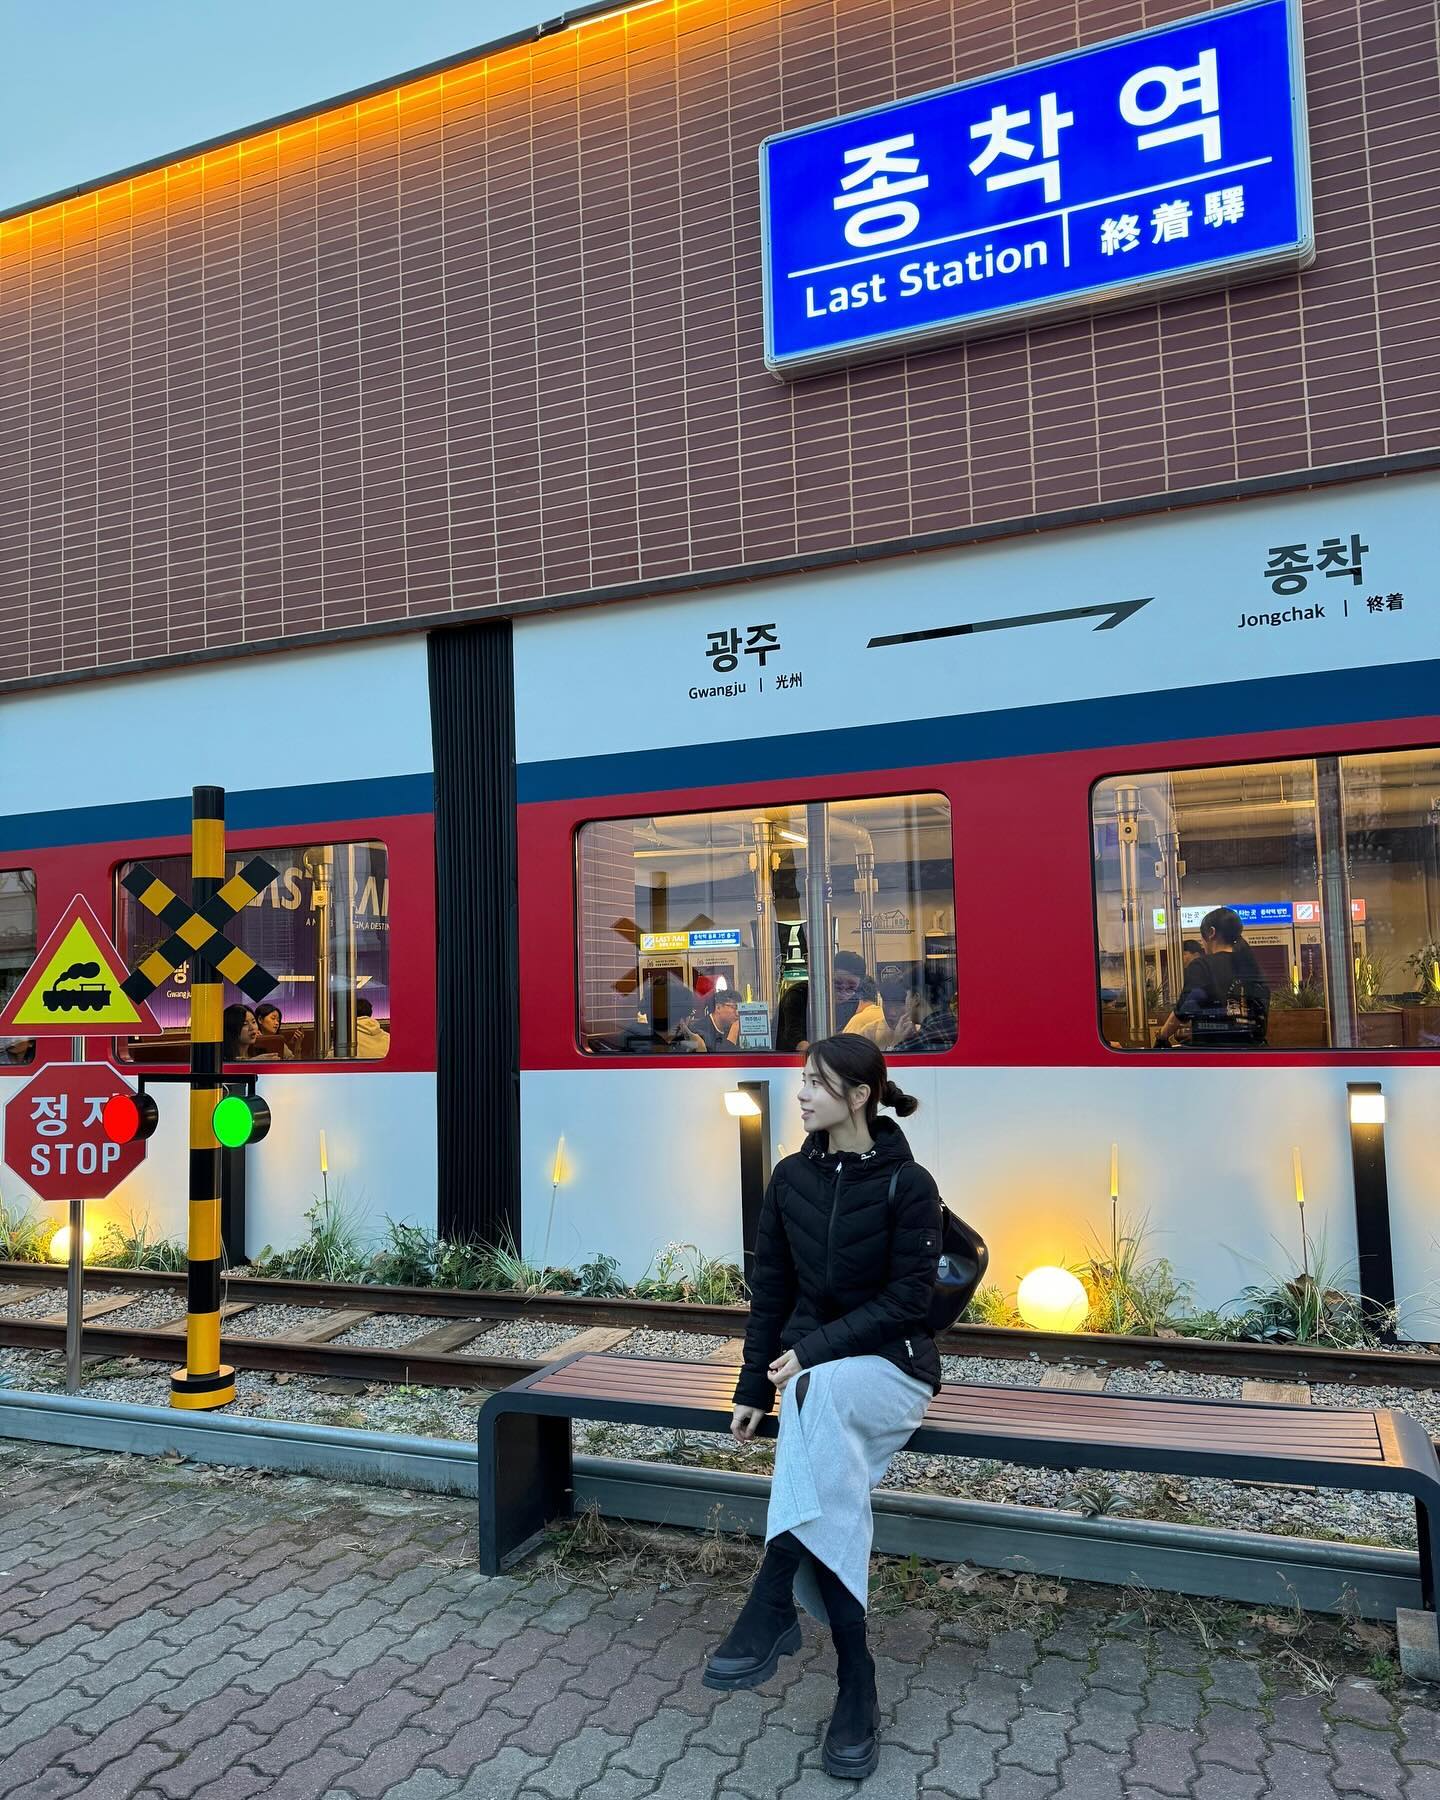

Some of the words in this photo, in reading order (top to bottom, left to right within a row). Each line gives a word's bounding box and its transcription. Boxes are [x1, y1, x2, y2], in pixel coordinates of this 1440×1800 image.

[833, 48, 1223, 248] 종착역
[806, 275, 887, 319] Last
[900, 239, 1048, 297] Station
[1264, 534, 1370, 596] 종착
[1238, 604, 1326, 629] Jongchak
[1366, 592, 1405, 614] 終着
[705, 623, 781, 673] 광주
[688, 681, 746, 701] Gwangju
[775, 671, 803, 689] 光州
[862, 920, 872, 928] 10
[31, 1143, 121, 1176] STOP
